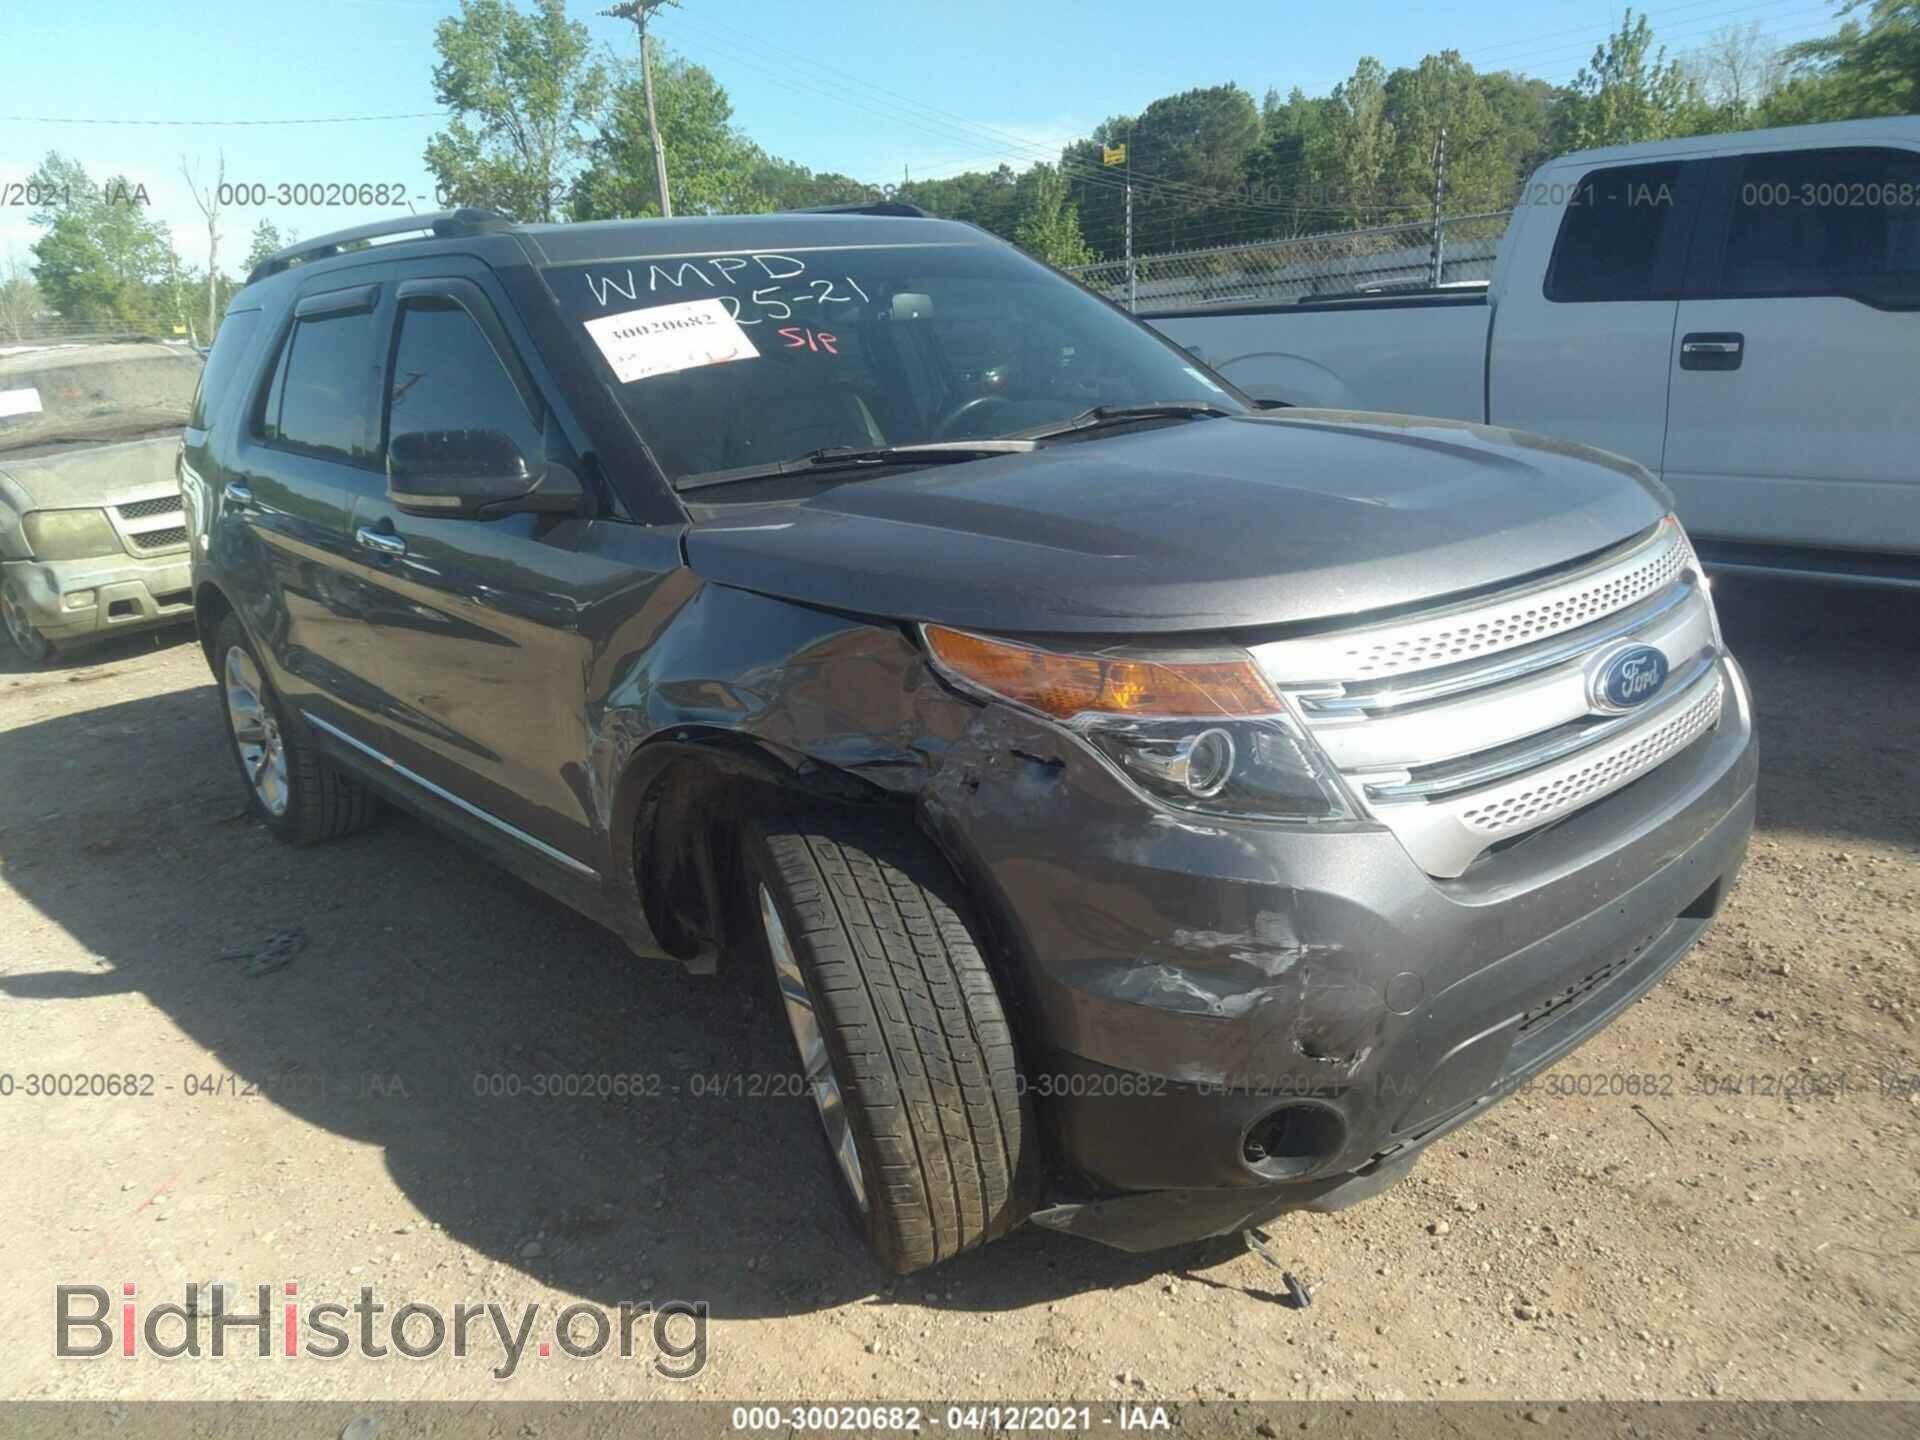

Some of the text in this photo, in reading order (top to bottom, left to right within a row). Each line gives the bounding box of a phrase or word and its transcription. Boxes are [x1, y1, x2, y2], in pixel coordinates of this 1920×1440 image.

[585, 255, 806, 306] WMPD
[612, 312, 718, 343] 30020682
[1621, 656, 1661, 698] Ford
